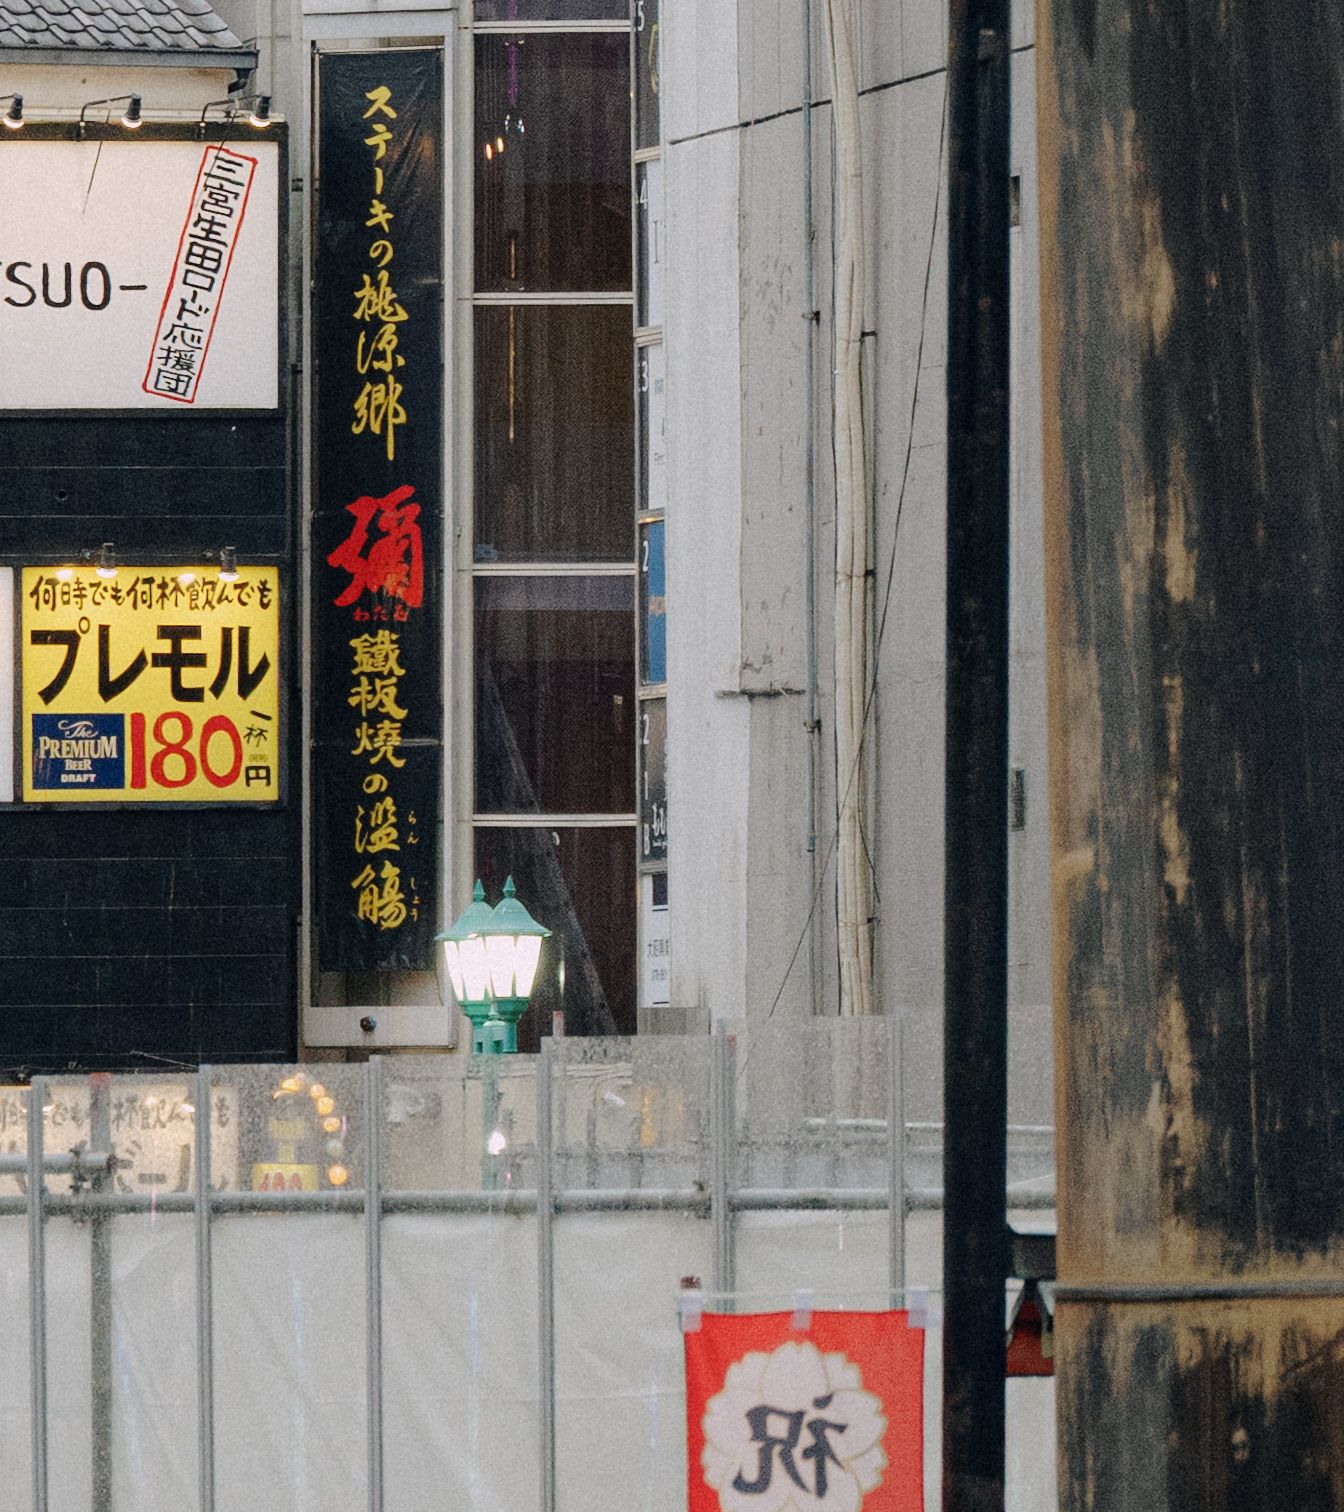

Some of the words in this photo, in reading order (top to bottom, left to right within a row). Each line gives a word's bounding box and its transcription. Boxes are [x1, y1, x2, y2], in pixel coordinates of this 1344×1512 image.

[153, 156, 245, 398] 三宮生田ロード応援団
[352, 85, 410, 462] ステーキの桃源郷
[30, 575, 272, 612] 何時でも何杯飲んでも
[30, 615, 271, 706] プレモル
[38, 736, 118, 760] PREMIUM
[64, 758, 92, 771] BEER
[130, 710, 244, 790] 180
[60, 773, 96, 783] DRAFT
[244, 765, 272, 788] 円
